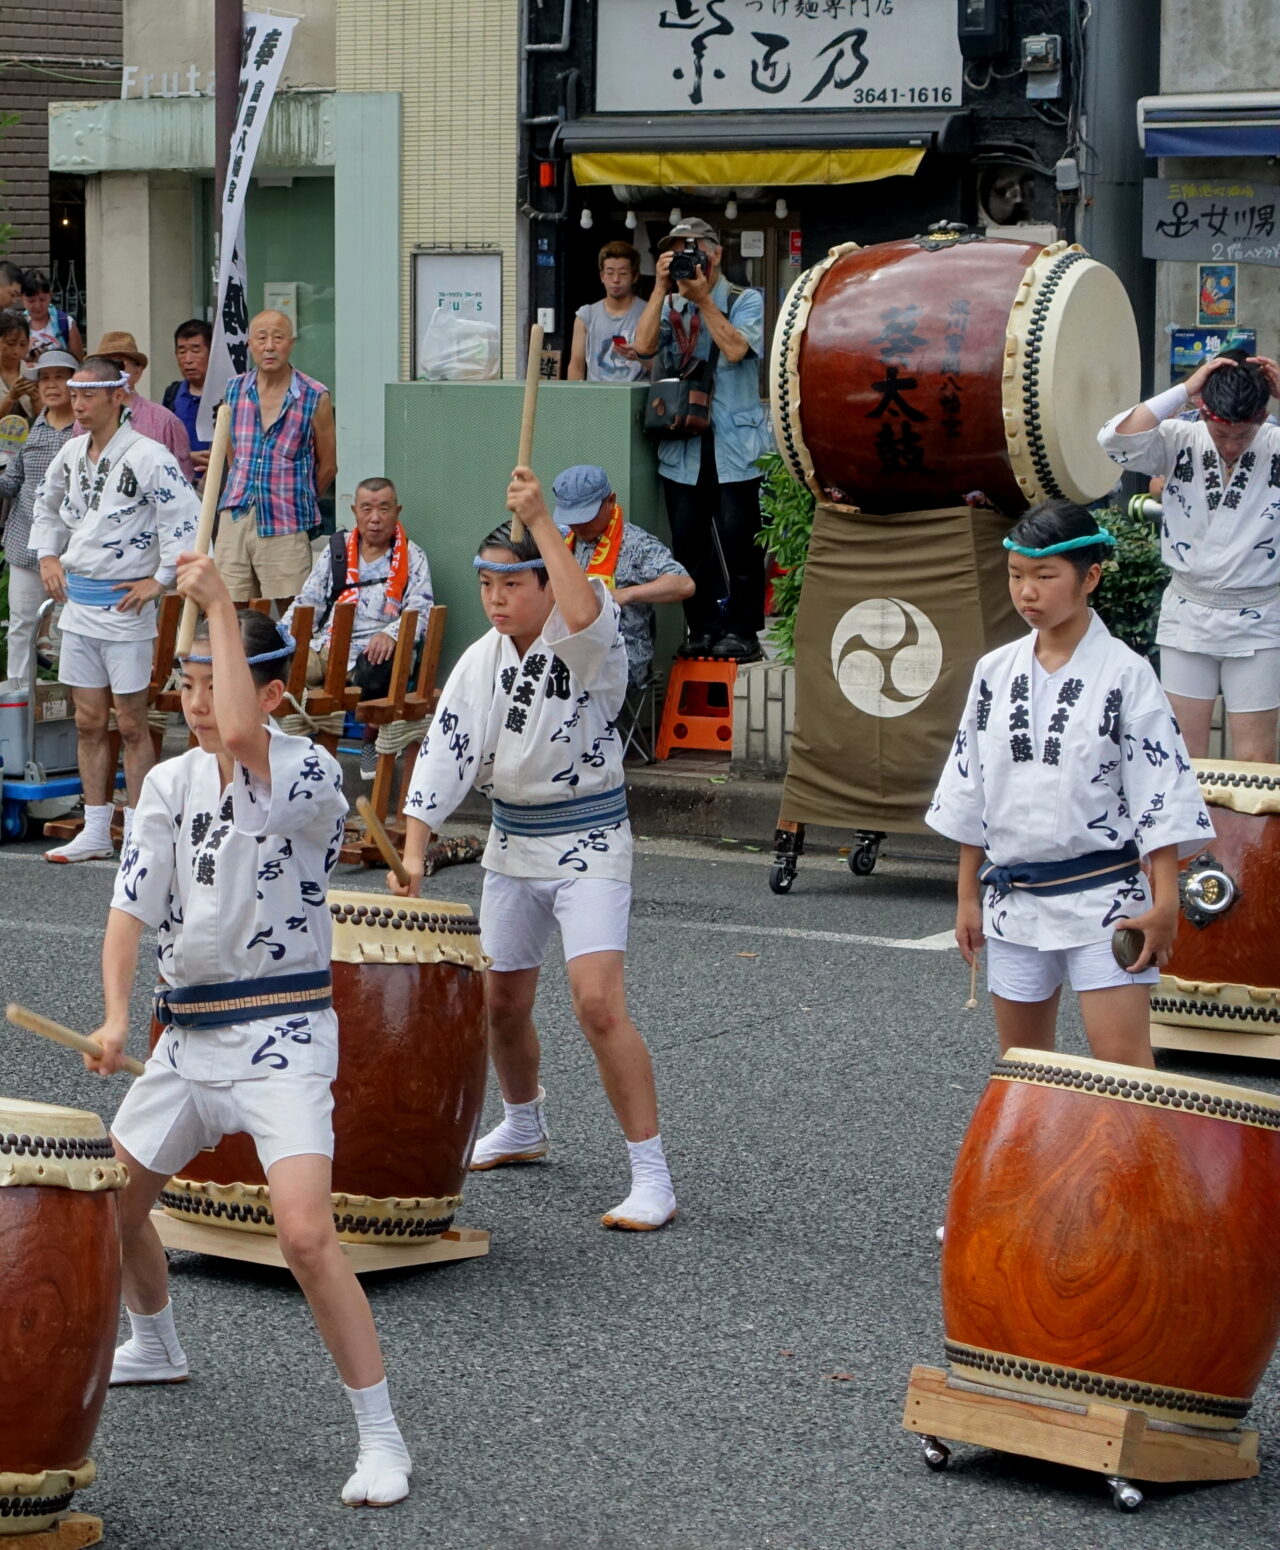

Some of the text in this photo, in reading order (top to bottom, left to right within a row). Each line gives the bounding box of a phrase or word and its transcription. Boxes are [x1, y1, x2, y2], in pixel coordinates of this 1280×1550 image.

[852, 87, 953, 104] 3641-1616
[1200, 203, 1275, 237] 女川男
[1202, 450, 1222, 511] 葵太鼓
[1222, 451, 1257, 510] 葵太鼓
[504, 653, 548, 734] 葵太鼓
[1009, 673, 1034, 763] 葵太鼓
[1042, 677, 1085, 766] 葵太鼓
